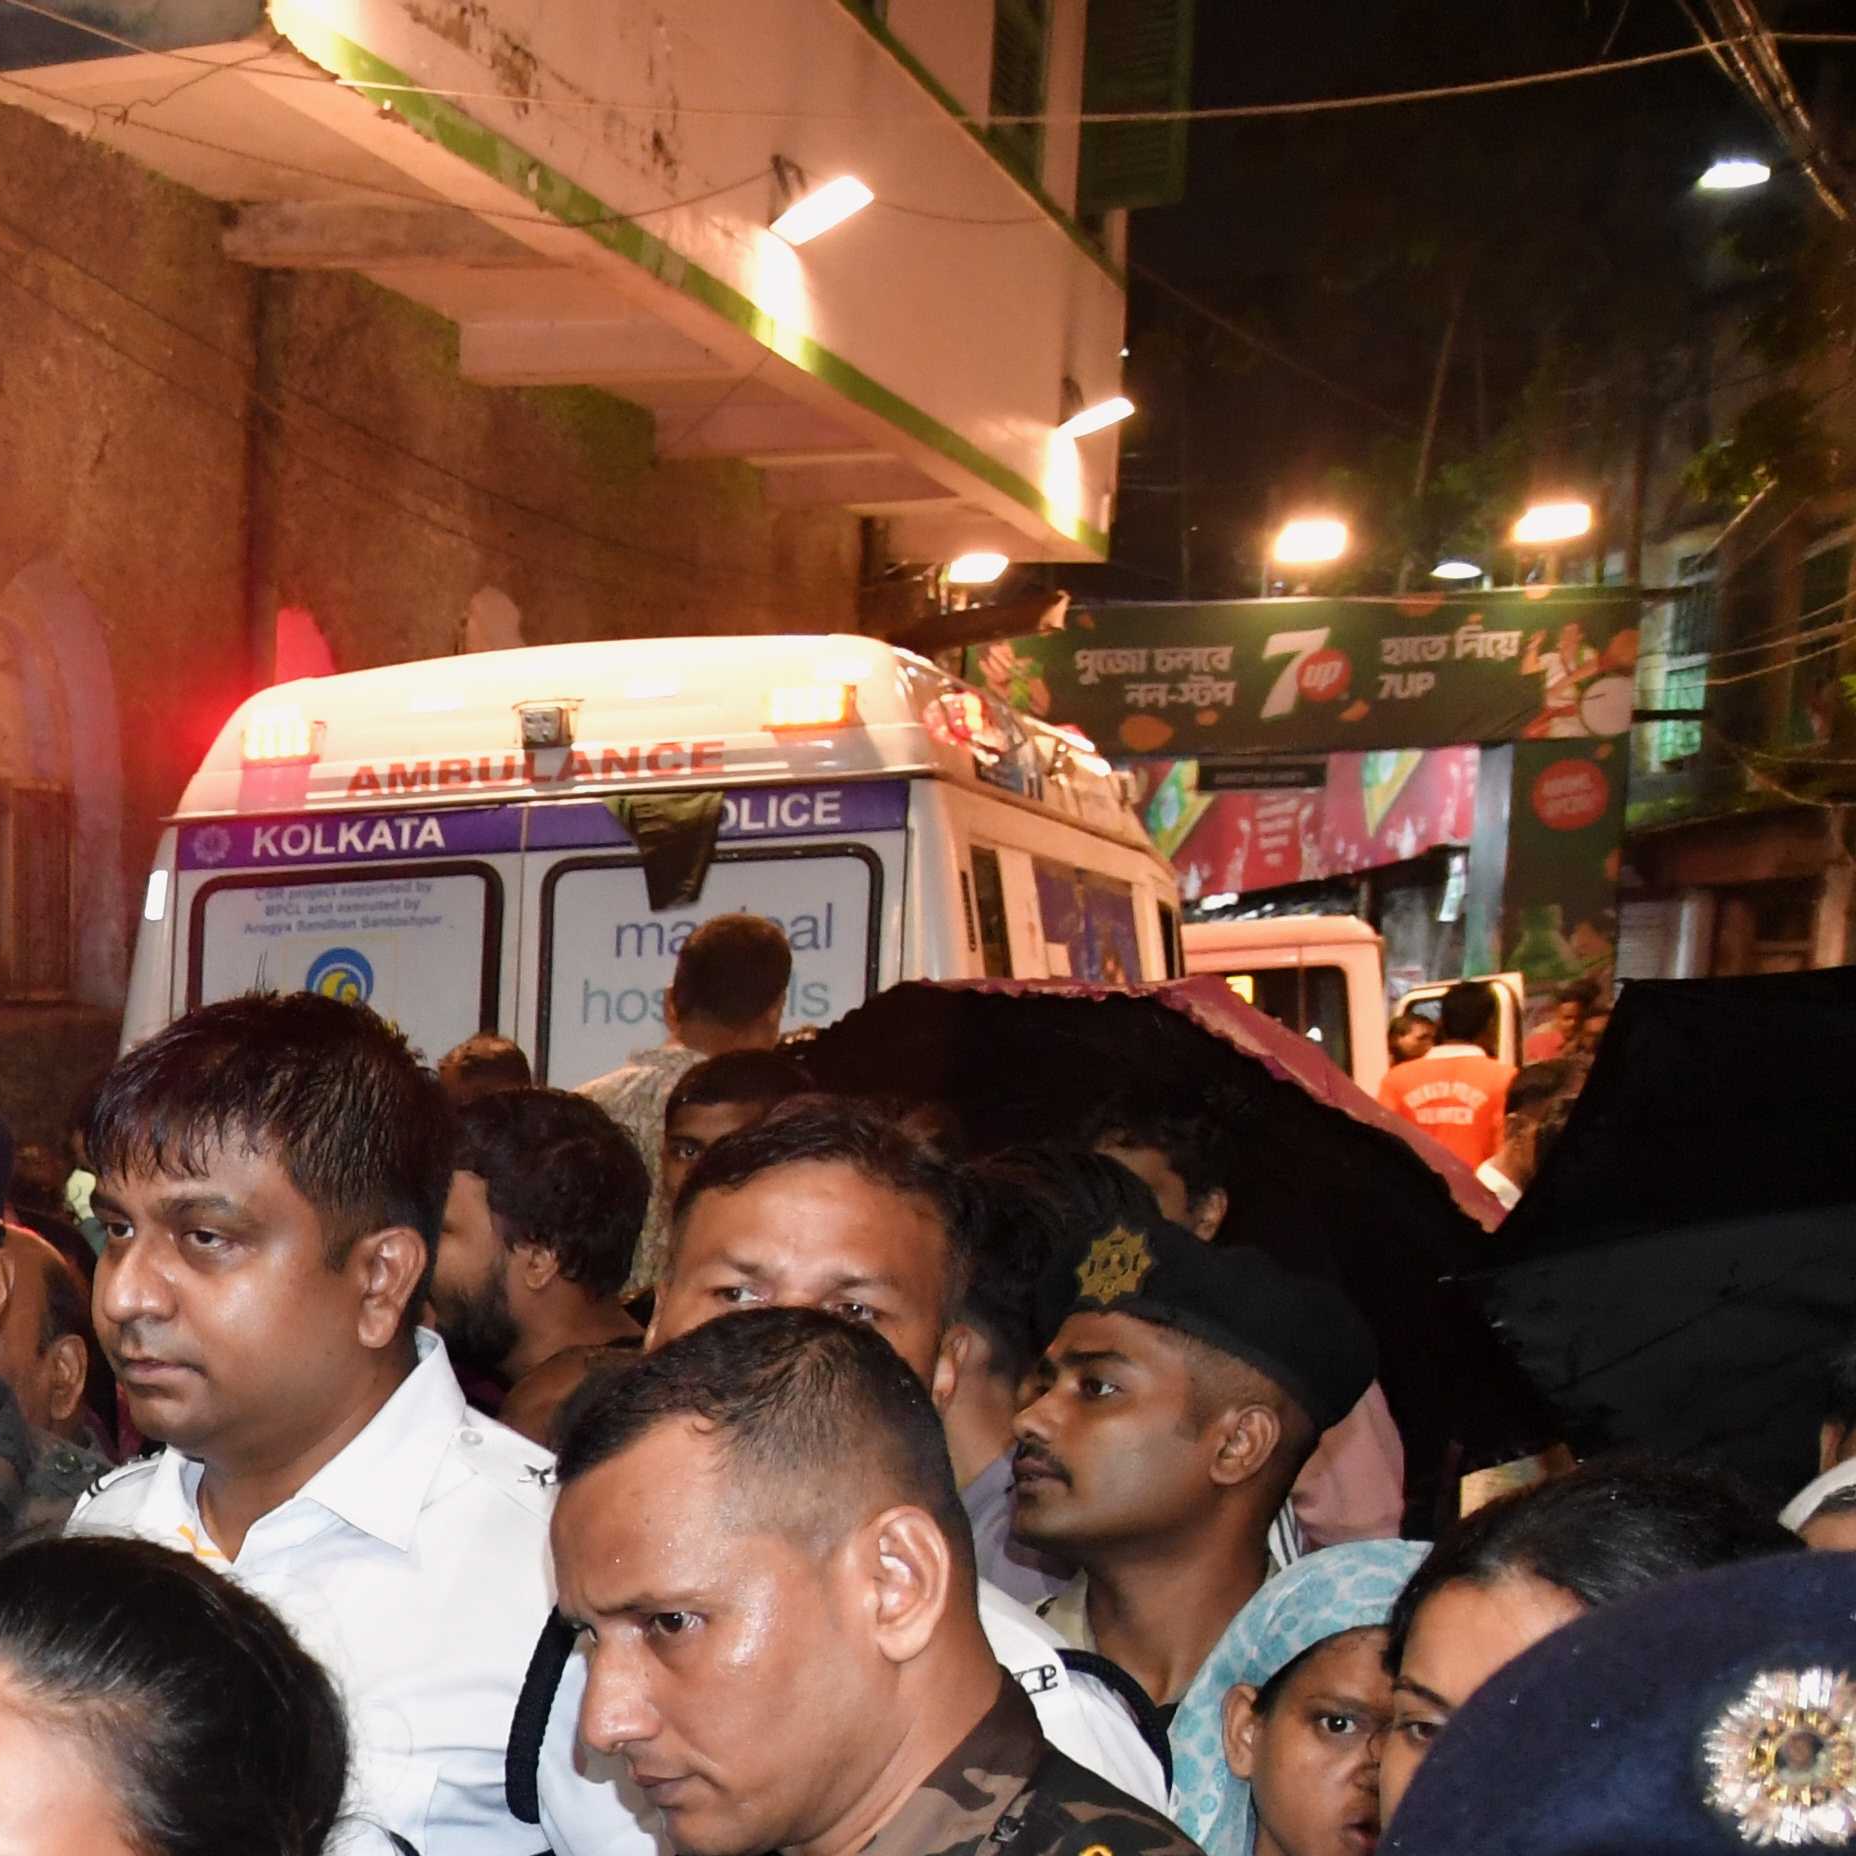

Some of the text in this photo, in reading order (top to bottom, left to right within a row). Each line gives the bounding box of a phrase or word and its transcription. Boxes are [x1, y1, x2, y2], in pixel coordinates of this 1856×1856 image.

[346, 741, 725, 798] AMBULANCE
[252, 791, 841, 860] KOLKATA OLICE
